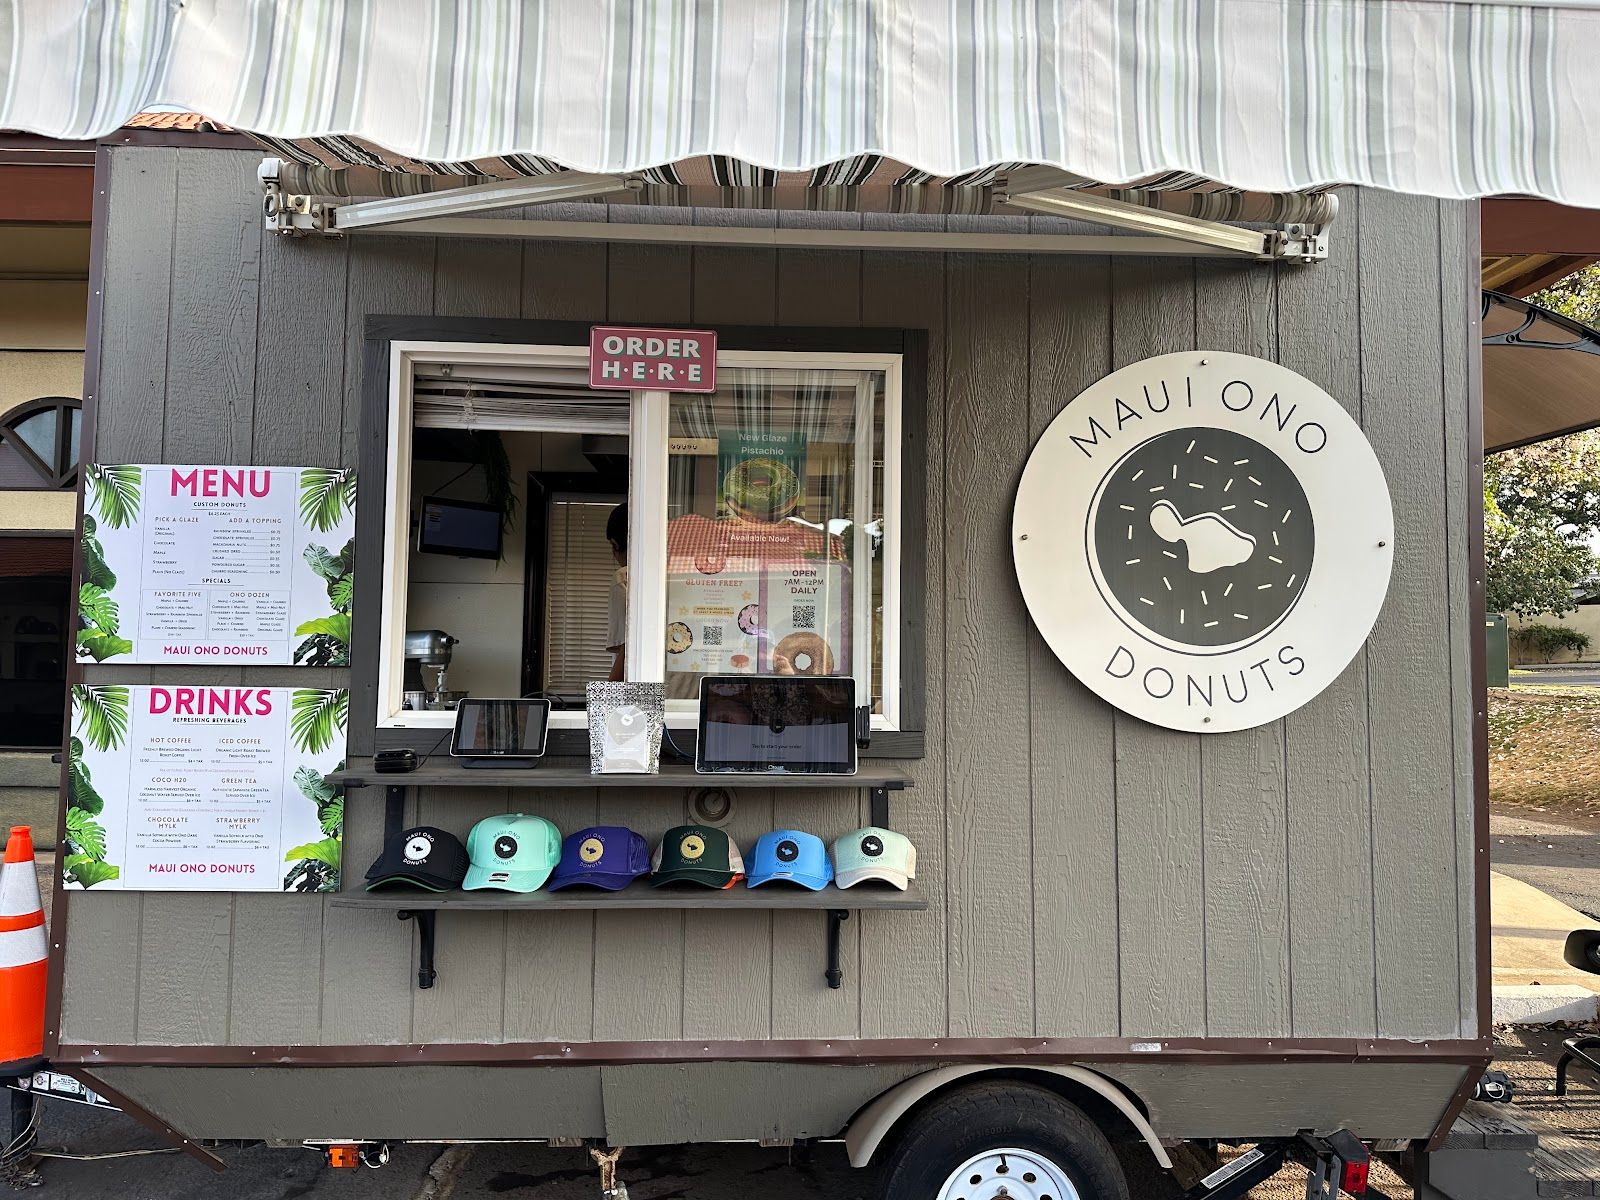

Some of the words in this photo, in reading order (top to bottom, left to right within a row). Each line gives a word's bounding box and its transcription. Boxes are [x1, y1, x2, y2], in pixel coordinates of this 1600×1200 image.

[602, 336, 700, 358] ORDER
[1069, 376, 1191, 458] MAUI
[1222, 380, 1327, 453] ONO
[739, 433, 759, 442] New
[761, 433, 787, 442] Glaze
[741, 446, 784, 455] Pistachio
[170, 468, 271, 498] MENU
[730, 534, 766, 542] Available
[768, 535, 790, 543] Now!
[164, 646, 190, 654] MAUI
[194, 646, 220, 655] ONO
[223, 646, 268, 655] DONUTS
[1104, 645, 1304, 707] DONUTS
[150, 688, 272, 716] DRINKS
[406, 832, 421, 841] MAUI
[422, 832, 434, 842] ONO
[493, 830, 506, 838] MAUI
[508, 831, 520, 840] ONO
[579, 834, 591, 843] MAUI
[593, 833, 605, 842] ONO
[680, 831, 693, 840] MAUI
[695, 831, 706, 840] ONO
[774, 835, 787, 844] MAUI
[790, 836, 800, 844] ONO
[874, 831, 885, 840] ONO
[149, 864, 176, 872] MAUI
[180, 864, 206, 872] ONO
[210, 864, 255, 873] DONUTS
